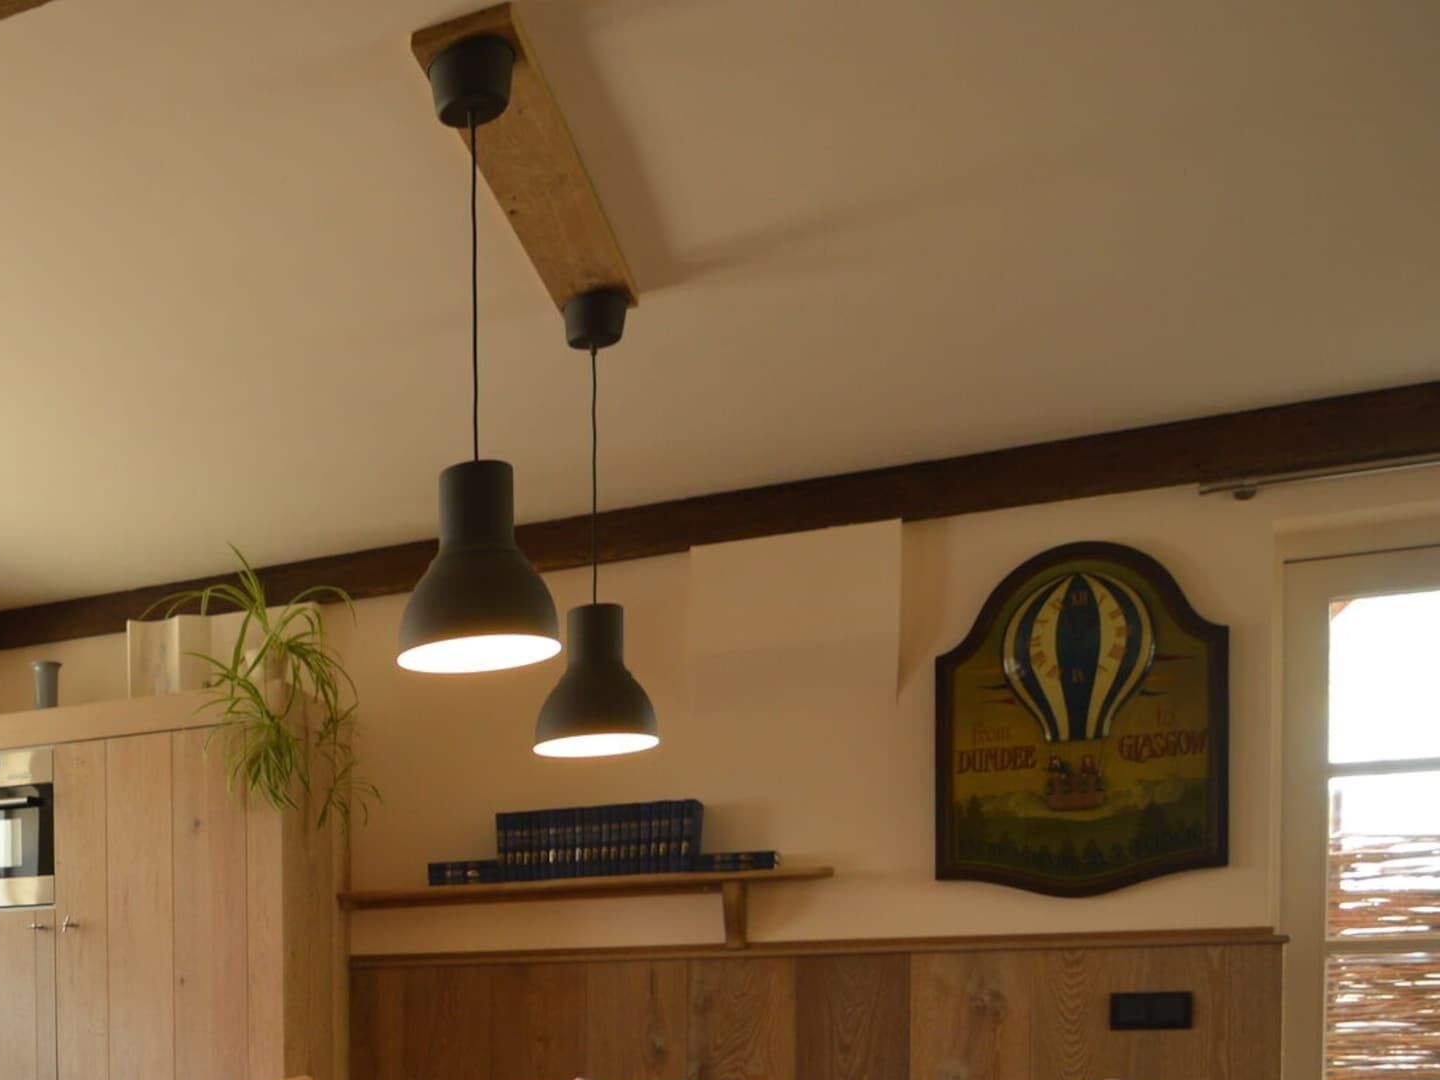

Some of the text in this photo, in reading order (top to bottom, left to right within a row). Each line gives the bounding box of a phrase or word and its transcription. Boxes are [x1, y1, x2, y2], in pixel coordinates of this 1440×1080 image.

[1156, 706, 1175, 727] to
[972, 721, 1011, 742] from
[1118, 728, 1207, 763] GLASGOW
[957, 745, 1037, 774] DUNDEE
